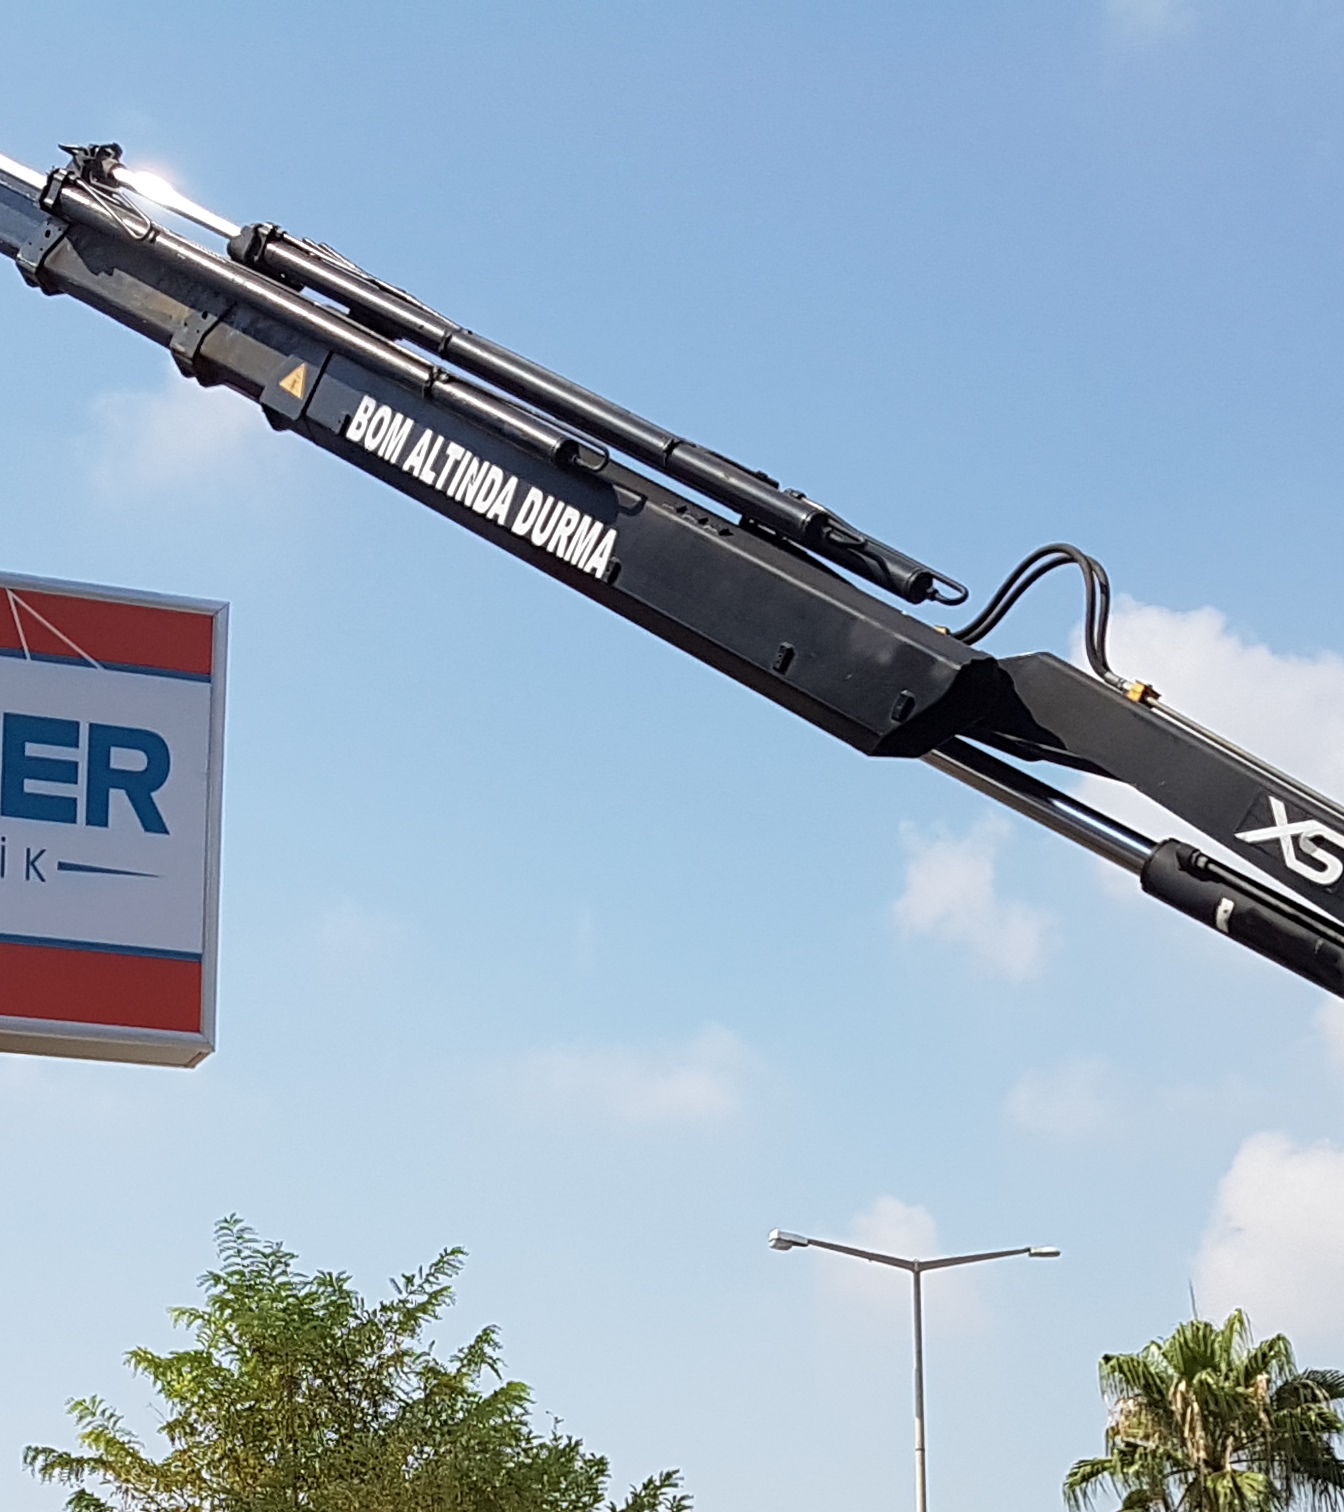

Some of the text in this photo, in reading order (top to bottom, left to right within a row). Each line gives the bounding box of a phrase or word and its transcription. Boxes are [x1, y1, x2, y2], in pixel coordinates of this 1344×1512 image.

[346, 394, 618, 579] BOM ALTINDA DURMA
